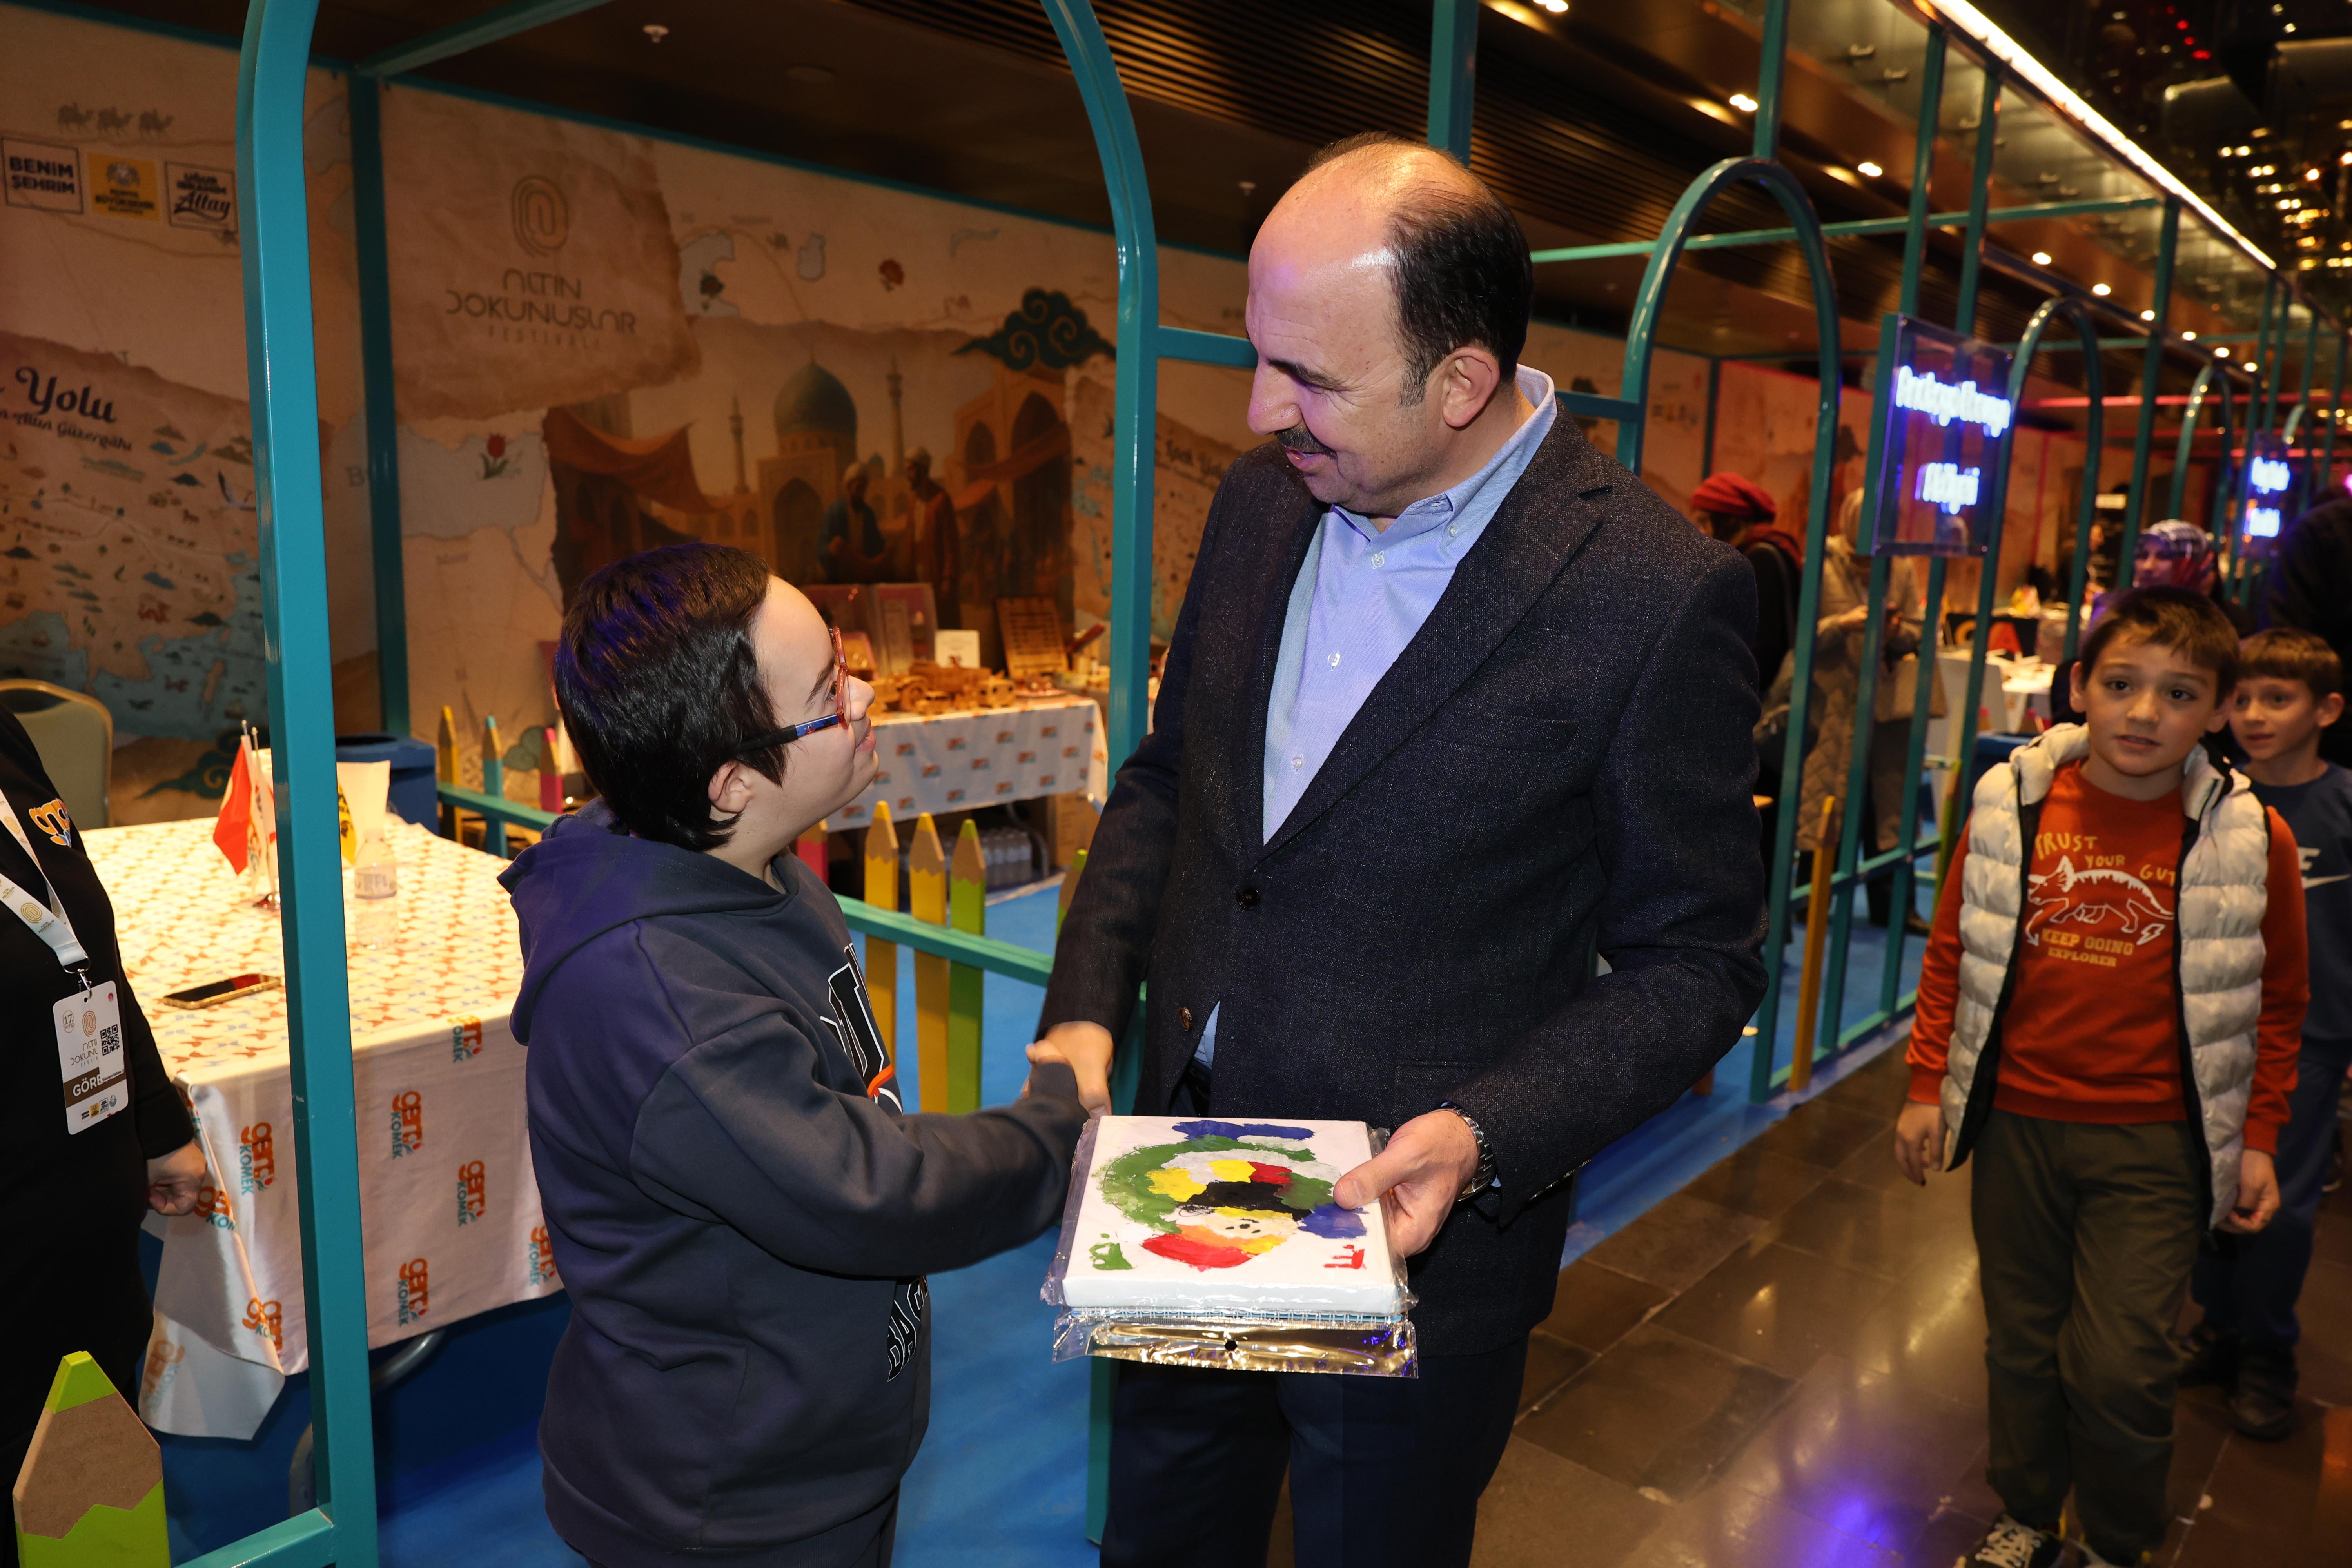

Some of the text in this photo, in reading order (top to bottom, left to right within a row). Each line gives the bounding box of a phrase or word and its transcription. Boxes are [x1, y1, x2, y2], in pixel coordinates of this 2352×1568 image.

[15, 366, 117, 424] Yolu
[2035, 832, 2098, 860] TRUST
[2085, 855, 2125, 869] YOUR
[2140, 864, 2176, 887] GUT
[2042, 929, 2135, 955] KEEP GOING
[2048, 947, 2117, 967] EXPLORER
[391, 1111, 403, 1160] KOMEK
[240, 1144, 255, 1197] KOMEK
[457, 1181, 468, 1227] KOMEK
[528, 1242, 540, 1286] KOMEK
[398, 1279, 409, 1327] KOMEK
